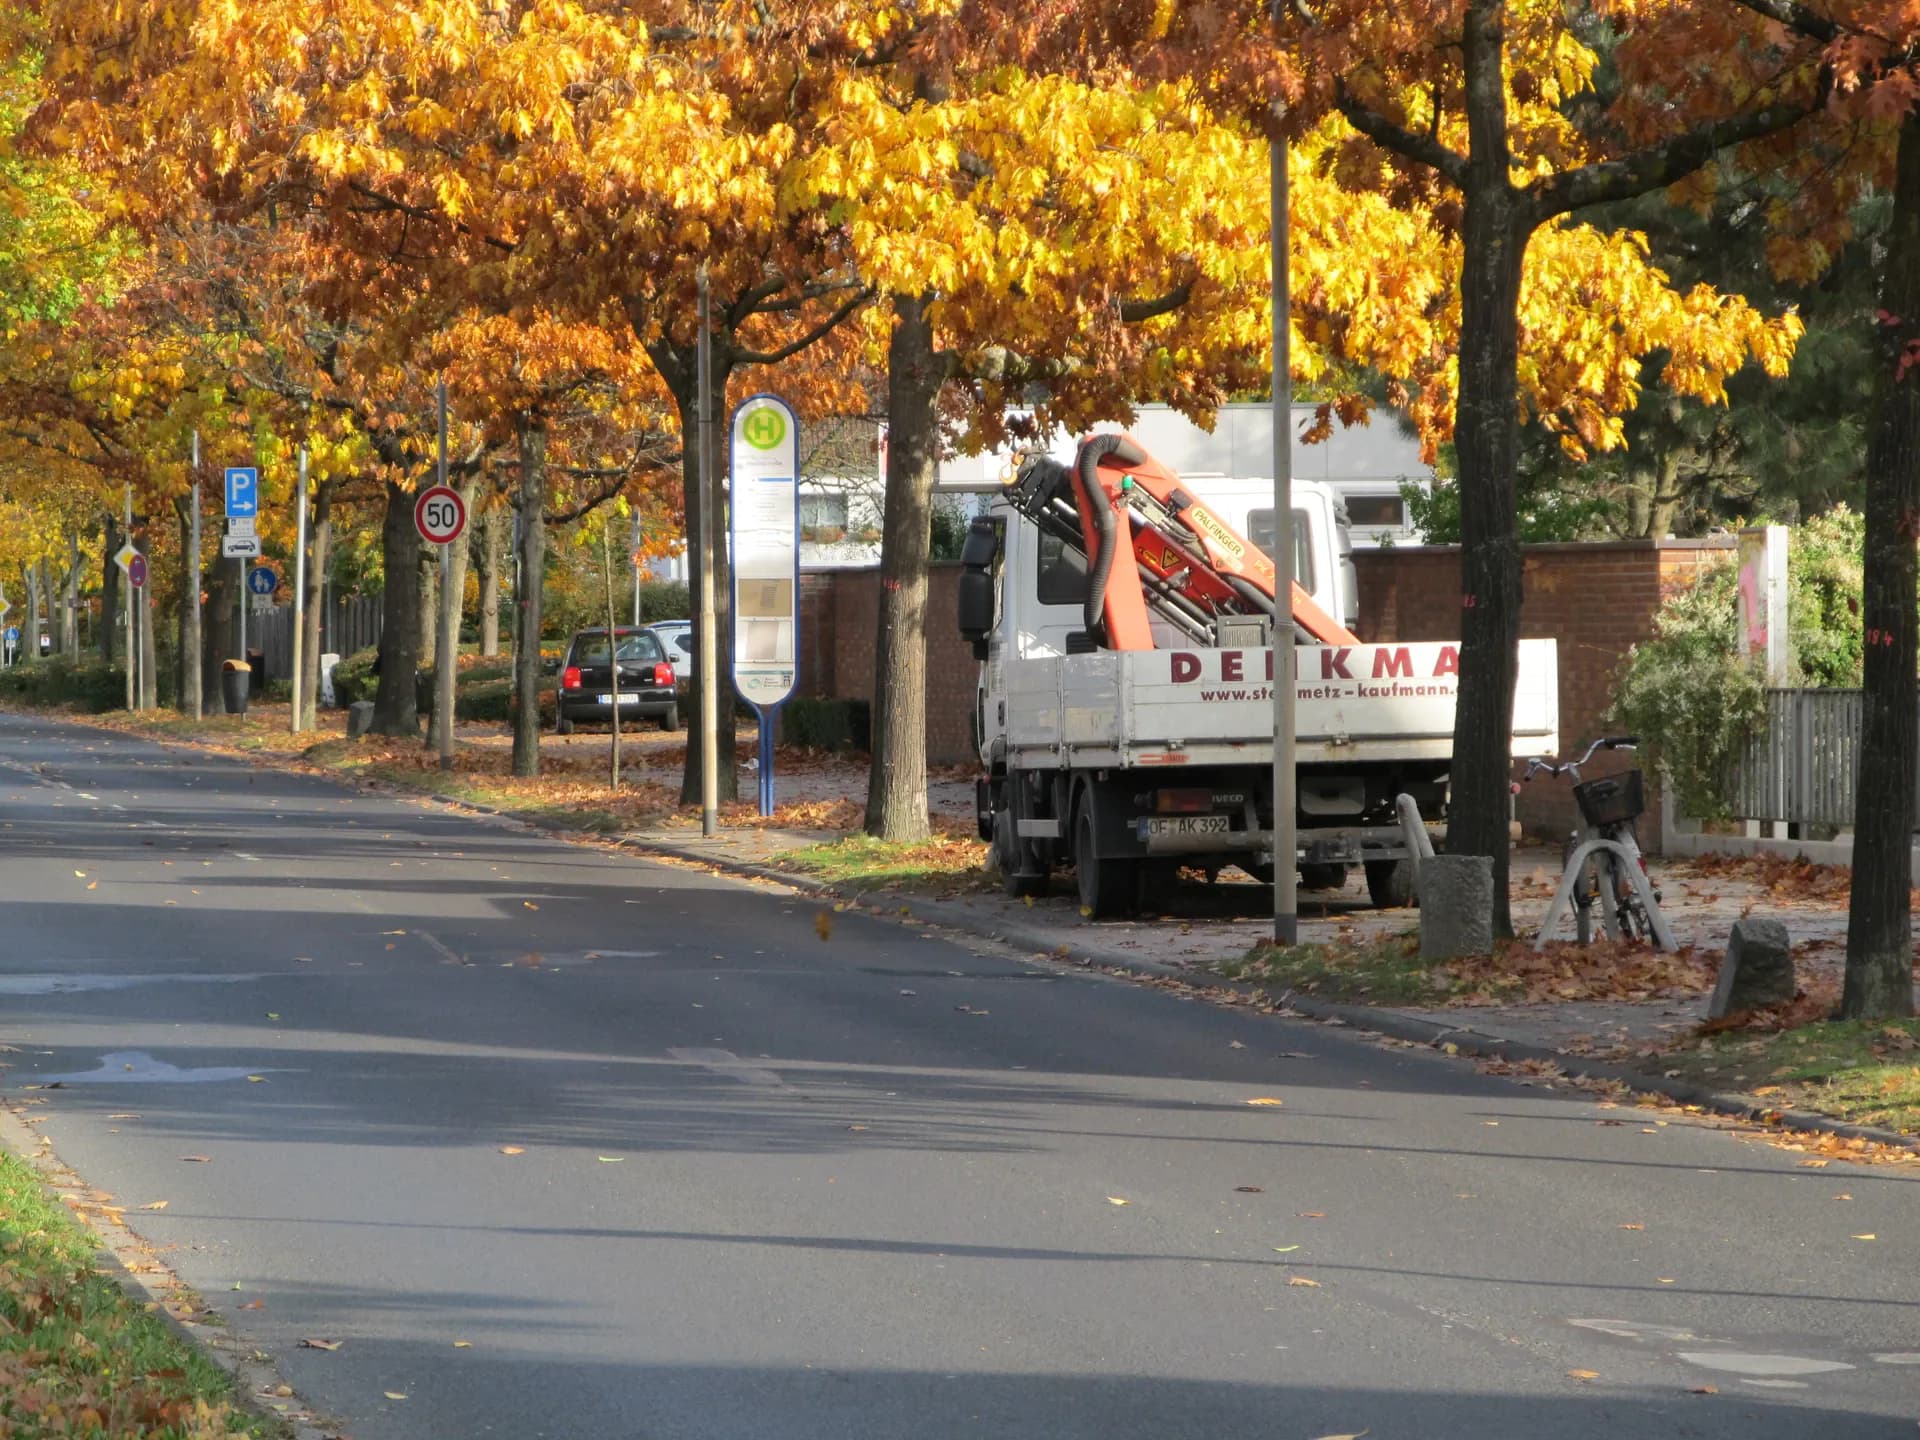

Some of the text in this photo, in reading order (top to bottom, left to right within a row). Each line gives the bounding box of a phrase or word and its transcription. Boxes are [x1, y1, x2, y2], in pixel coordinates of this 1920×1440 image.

[754, 416, 775, 441] H
[232, 473, 250, 501] P
[427, 503, 455, 528] 50
[1194, 509, 1242, 555] PALFINGER
[1171, 646, 1459, 683] DEKMA
[1211, 793, 1244, 803] IVECO
[1149, 817, 1228, 834] OF AK 392
